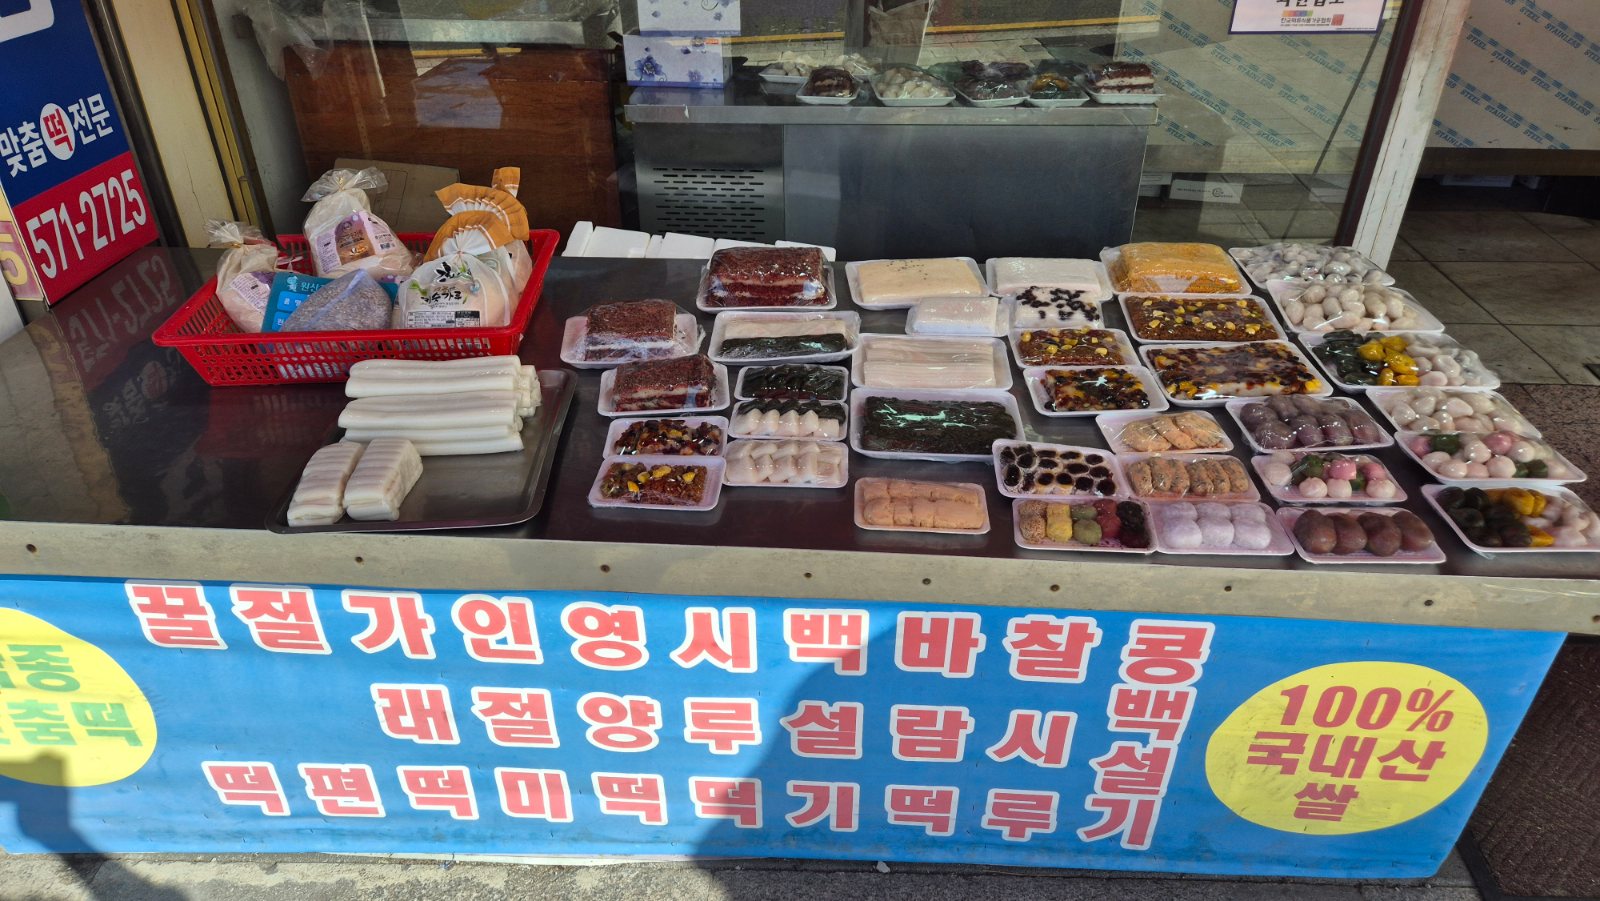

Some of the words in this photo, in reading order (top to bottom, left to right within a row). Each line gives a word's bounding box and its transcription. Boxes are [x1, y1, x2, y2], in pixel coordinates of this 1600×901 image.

[26, 169, 147, 279] 571-2725
[0, 643, 81, 693] 종
[0, 698, 143, 747] 춤떡
[1280, 684, 1455, 732] 100%
[1078, 620, 1215, 850] 콩백설기
[1246, 731, 1446, 782] 국내산
[1293, 782, 1360, 822] 쌀
